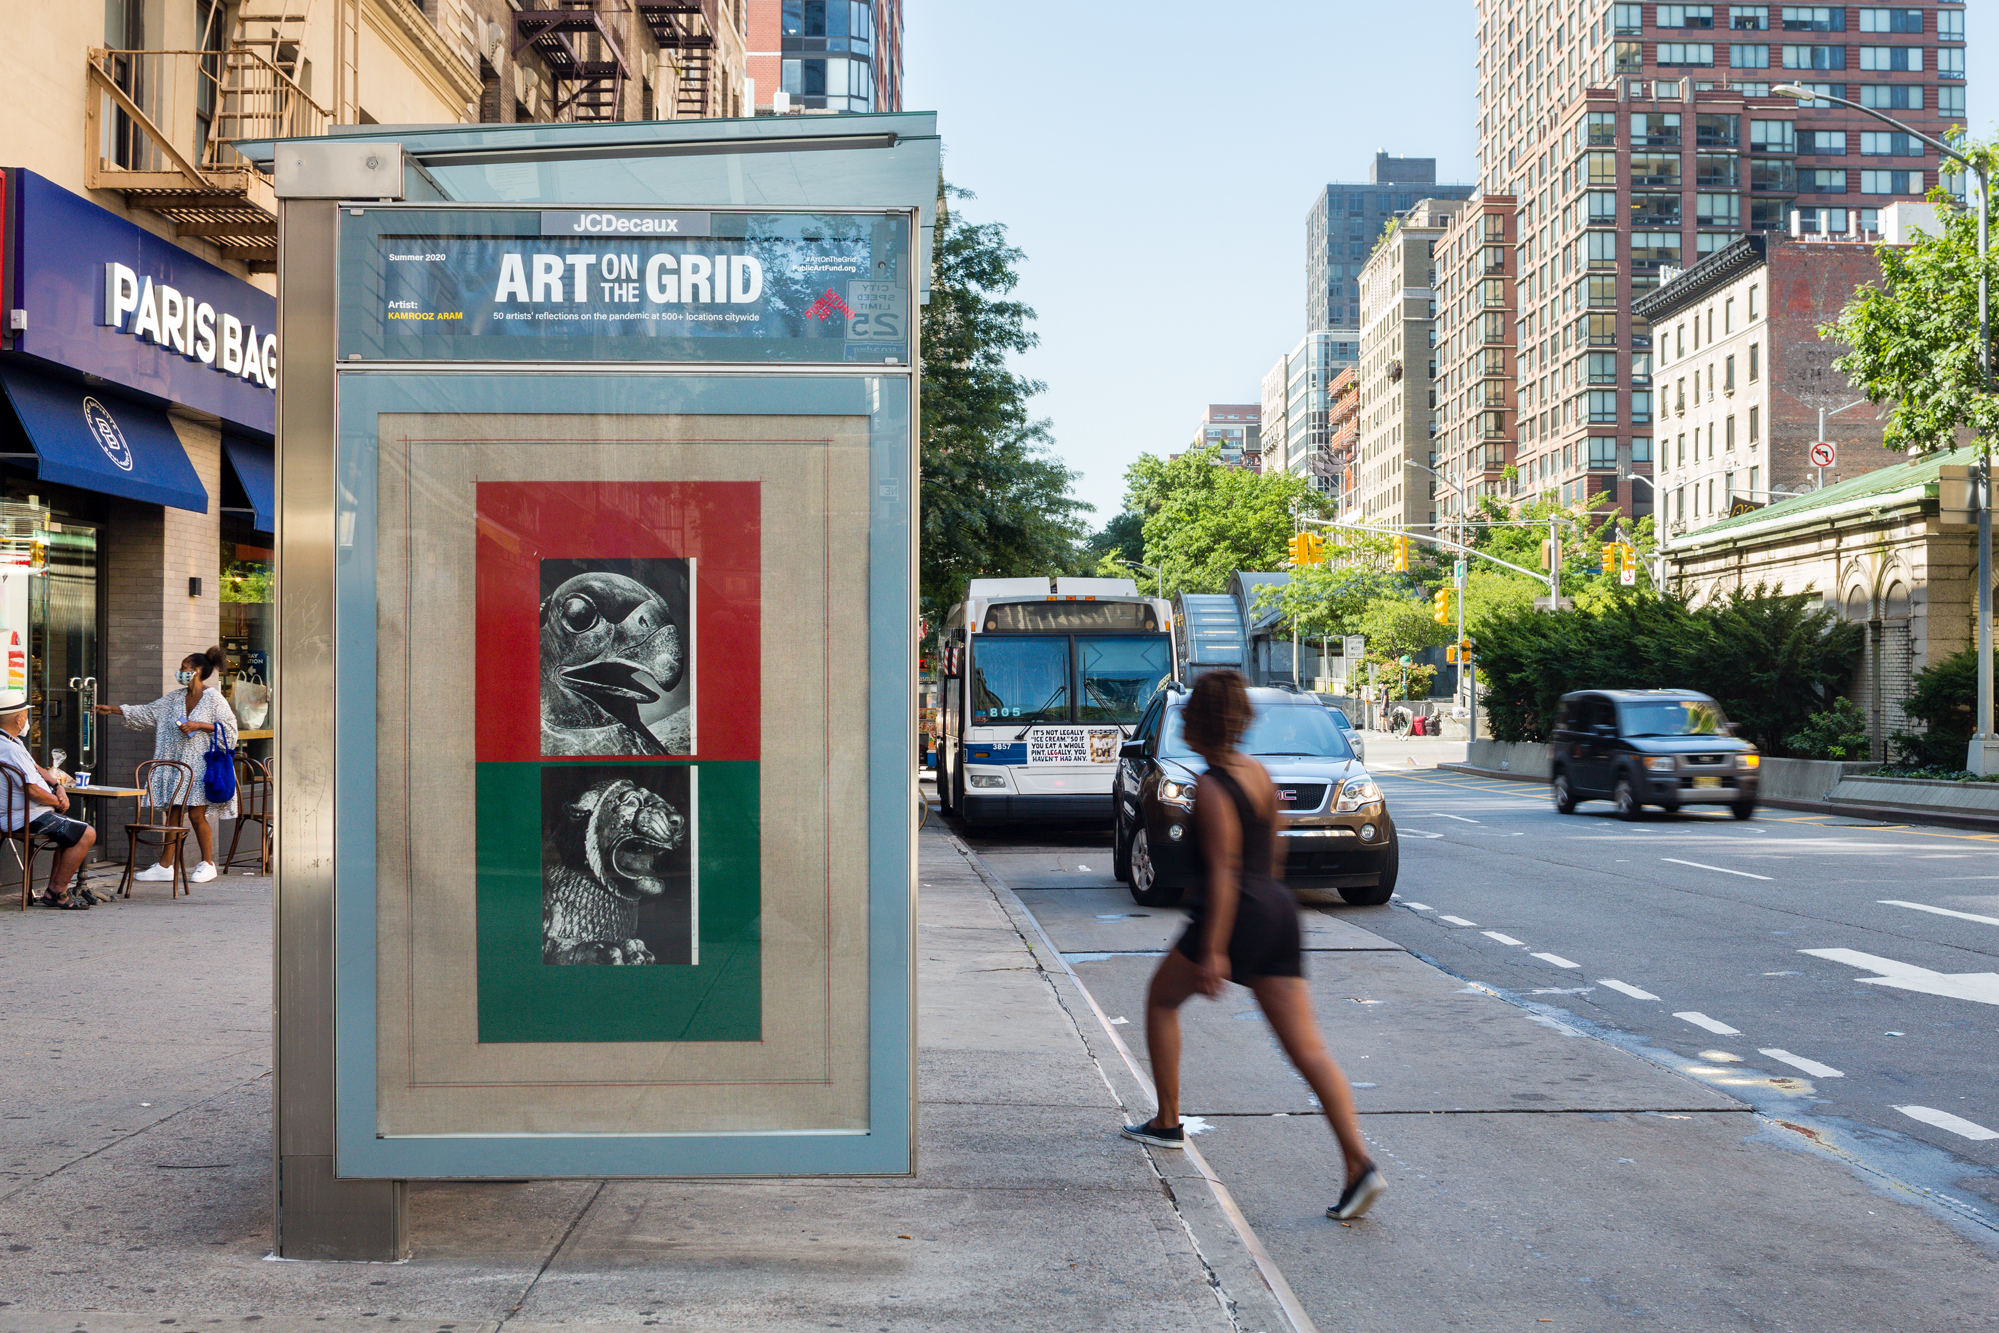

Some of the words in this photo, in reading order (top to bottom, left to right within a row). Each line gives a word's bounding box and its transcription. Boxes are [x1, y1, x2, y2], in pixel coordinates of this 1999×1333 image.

[573, 213, 679, 233] JCDecaux
[388, 253, 423, 262] Summer
[425, 253, 446, 262] 2020
[601, 253, 638, 280] ON
[494, 253, 597, 303] ART
[645, 253, 763, 304] GRID
[791, 264, 857, 273] PublicArtFund.org
[600, 282, 640, 303] THE
[104, 261, 217, 365] PARIS
[387, 300, 418, 309] Artist:
[803, 287, 837, 320] PUBLIC
[817, 300, 837, 322] ART
[833, 294, 857, 320] FUND
[387, 311, 435, 320] KAMROOZ
[437, 311, 463, 320] ARAM
[493, 312, 504, 320] 50
[535, 311, 580, 320] reflections
[593, 311, 608, 320] the
[609, 311, 650, 322] pandemic
[651, 312, 660, 320] at
[661, 312, 684, 321] 500+
[686, 312, 724, 322] locations
[724, 312, 760, 322] citywide
